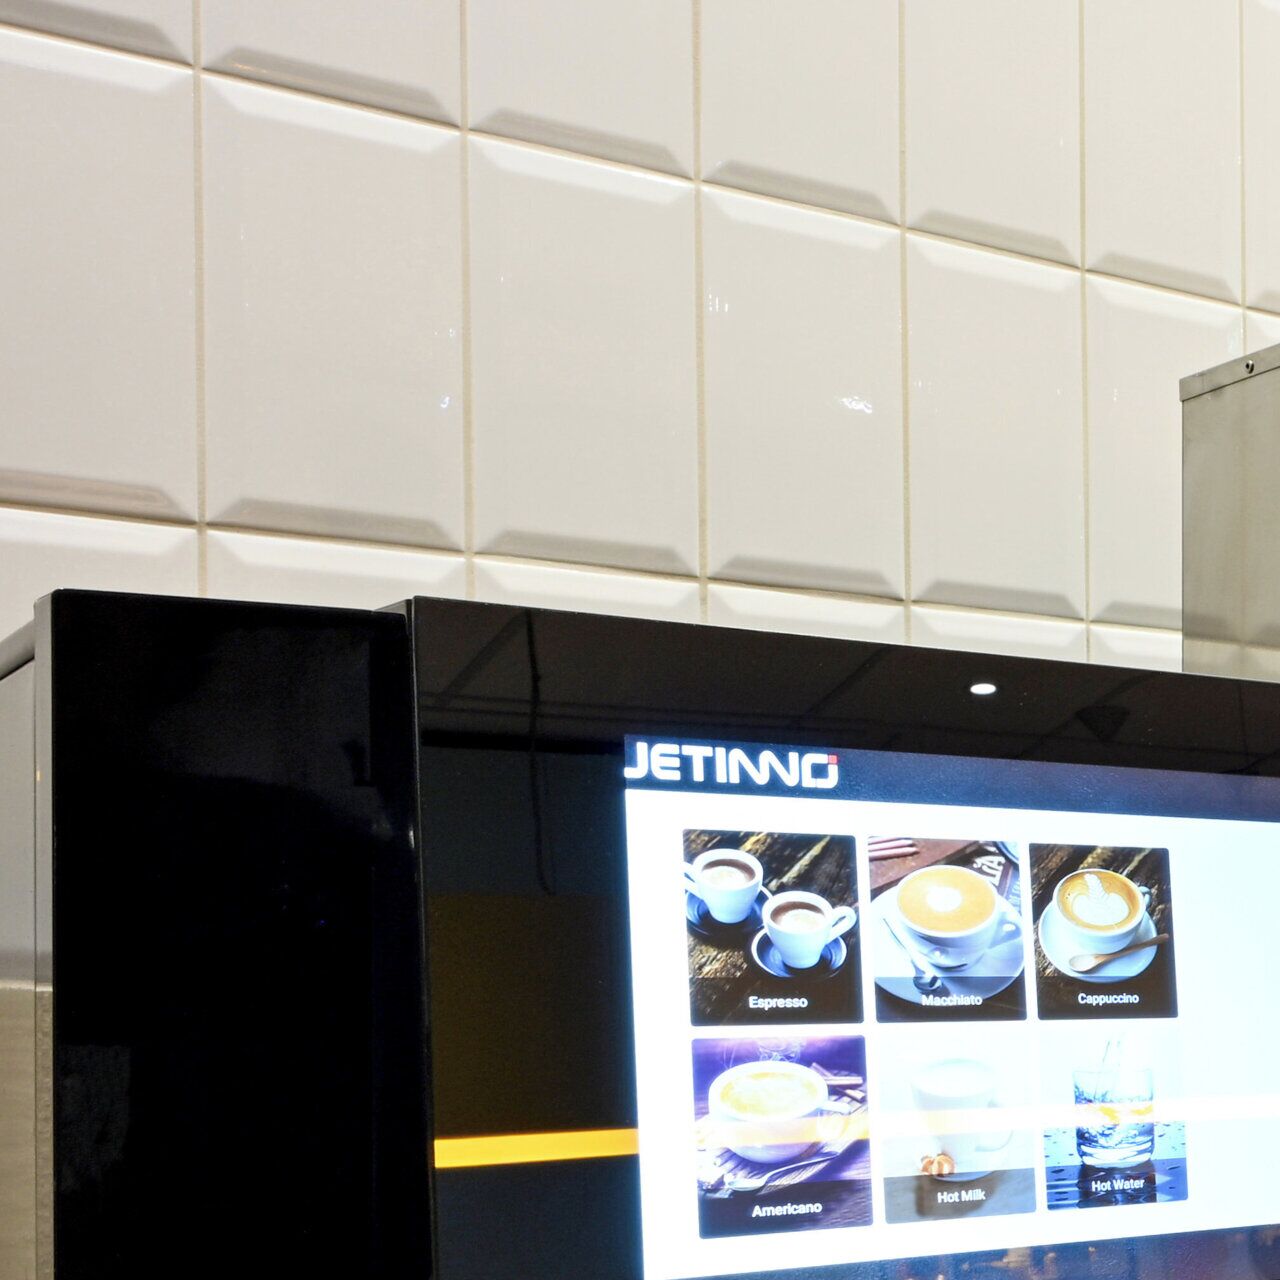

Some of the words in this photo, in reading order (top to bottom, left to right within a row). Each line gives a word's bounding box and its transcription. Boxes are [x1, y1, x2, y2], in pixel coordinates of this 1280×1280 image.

[748, 995, 808, 1010] Espresso
[921, 992, 983, 1007] Macchiato
[1078, 993, 1140, 1006] Cappuccino
[1091, 1178, 1111, 1192] Hot
[1113, 1176, 1145, 1190] Water
[937, 1188, 958, 1203] Hot
[961, 1187, 986, 1202] Milk
[752, 1200, 823, 1217] Americano
